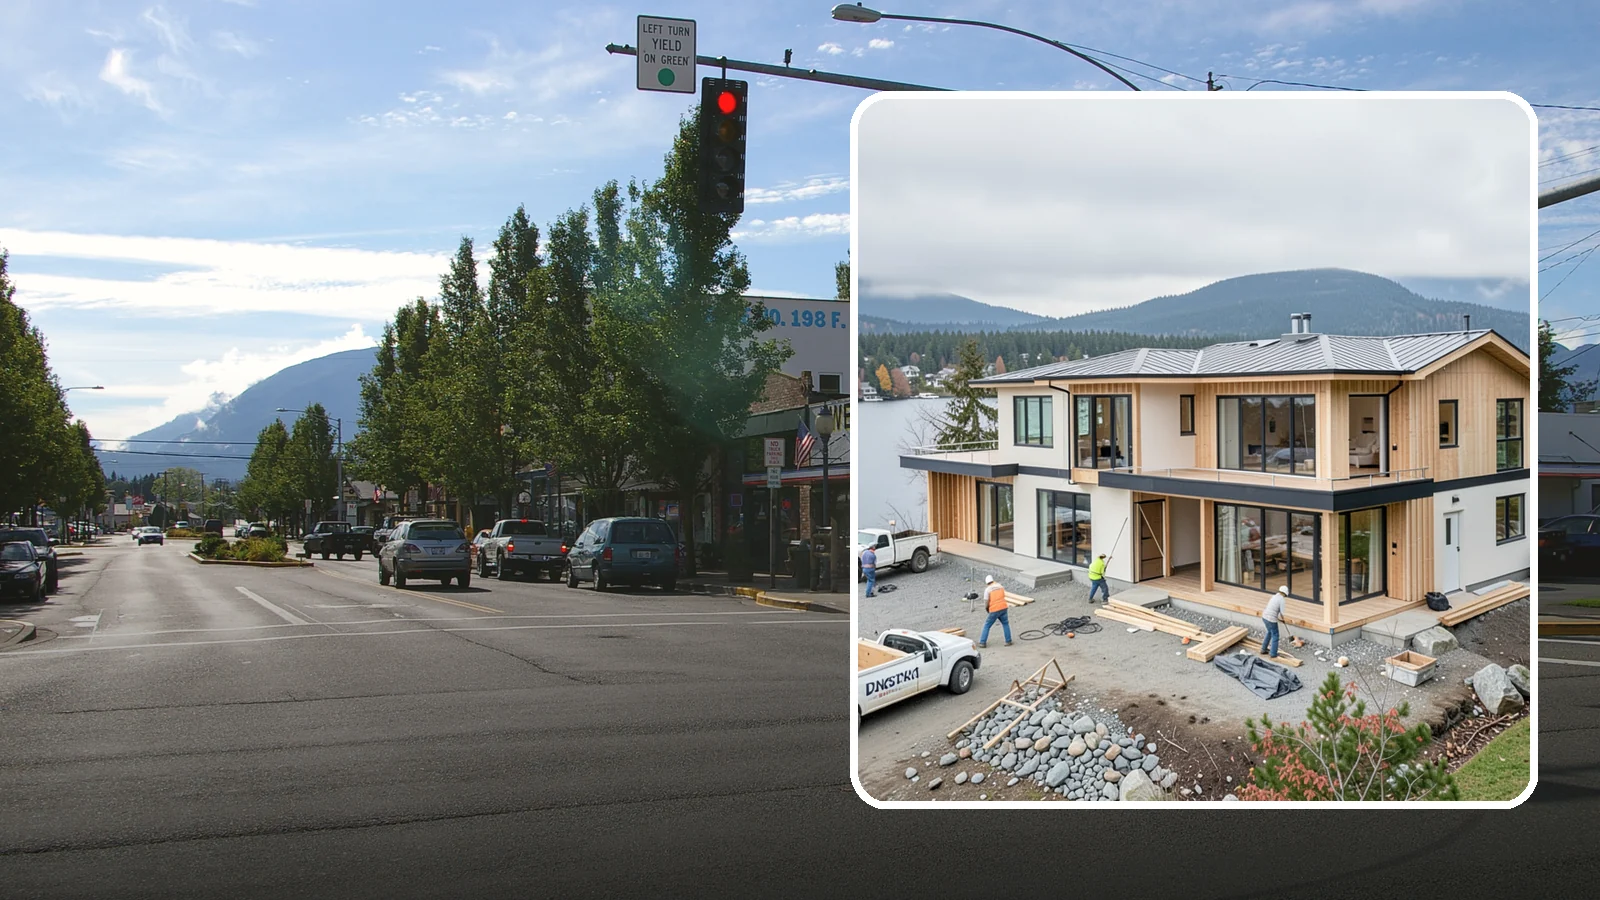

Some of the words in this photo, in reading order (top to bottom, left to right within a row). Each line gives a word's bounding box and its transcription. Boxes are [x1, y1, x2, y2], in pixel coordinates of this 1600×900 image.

[643, 23, 663, 35] LEFT
[668, 25, 690, 37] TURN
[652, 37, 682, 52] YIELD
[644, 53, 656, 64] ON
[661, 54, 690, 66] GREEN
[791, 309, 826, 328] 198
[832, 311, 847, 329] F.
